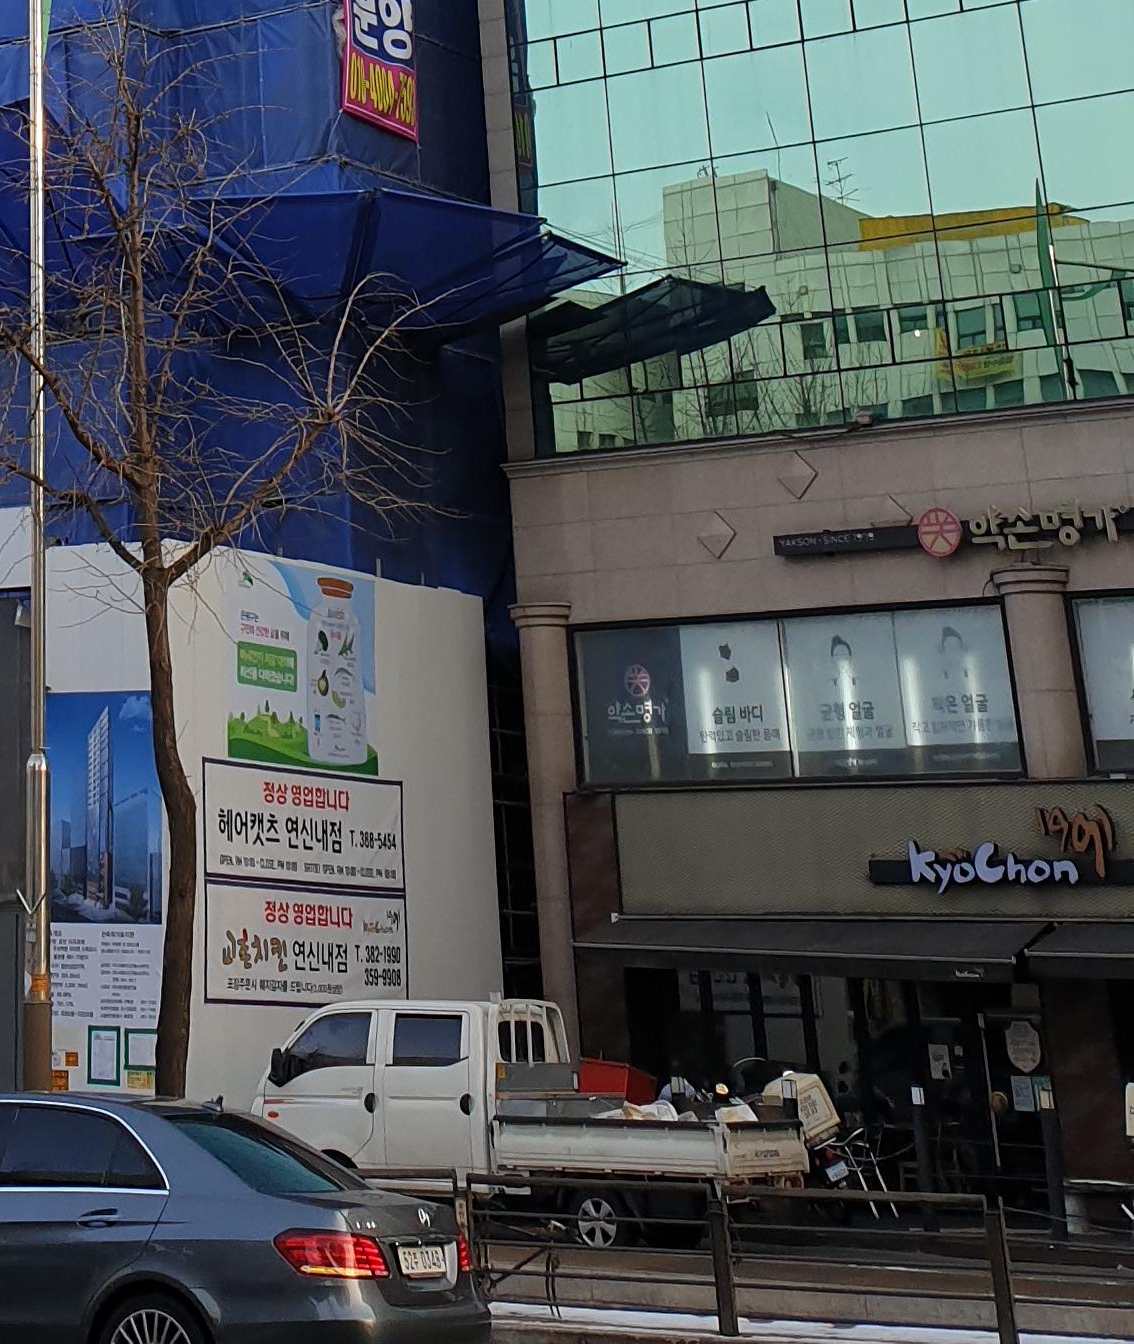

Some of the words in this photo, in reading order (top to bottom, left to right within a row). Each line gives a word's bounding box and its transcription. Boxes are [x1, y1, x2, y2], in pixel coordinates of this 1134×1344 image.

[969, 501, 1118, 551] 약손명가
[607, 699, 667, 724] 약손명가
[712, 704, 736, 725] 슬림
[739, 703, 764, 724] 바디
[848, 700, 875, 721] 얼굴
[961, 692, 989, 714] 얼굴
[263, 780, 288, 805] 정상
[290, 784, 350, 812] 영업합니다
[285, 815, 342, 854] 연신내점
[907, 839, 1080, 895] KyoChon
[265, 900, 289, 924] 정상
[292, 902, 353, 929] 영업합니다
[292, 939, 348, 974] 연신내점
[365, 944, 401, 964] 382-1990
